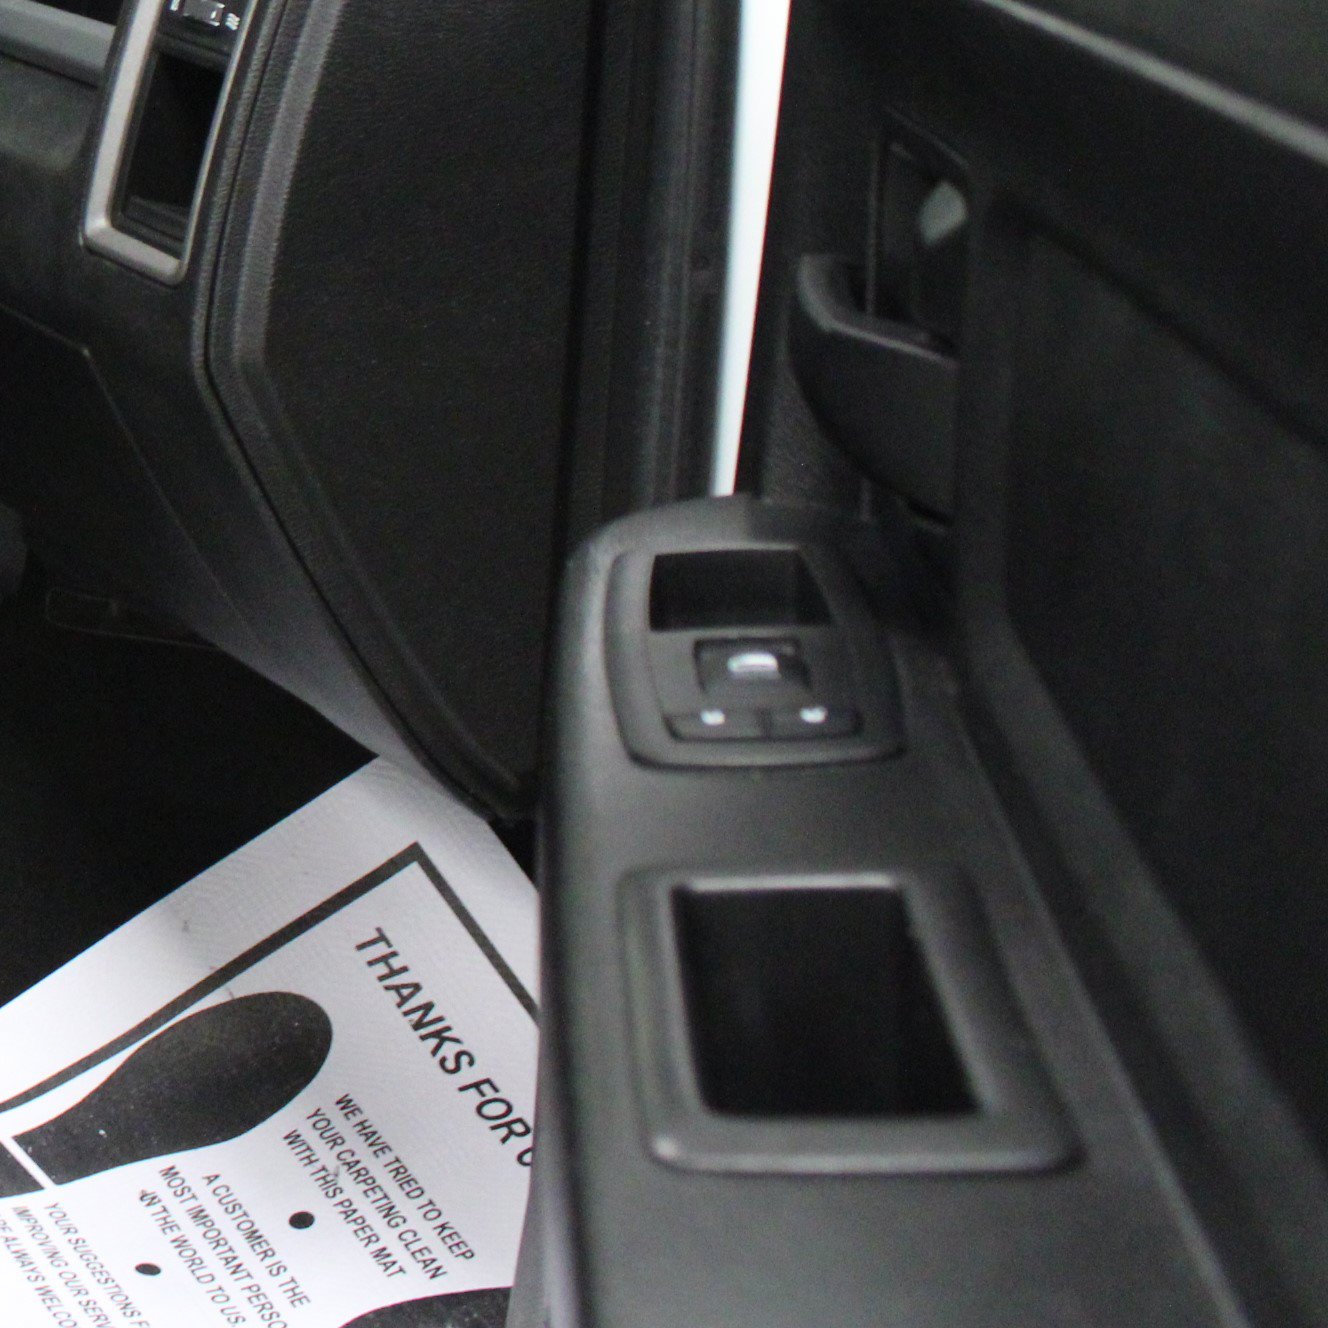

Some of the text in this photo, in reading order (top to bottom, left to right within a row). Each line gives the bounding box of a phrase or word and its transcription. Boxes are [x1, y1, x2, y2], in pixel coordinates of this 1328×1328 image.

[355, 927, 531, 1145] THANKS FOR
[159, 1165, 288, 1328] MOST IMPORTANT PERSO
[202, 1173, 311, 1309] A CUSTOMER IS THE
[282, 1129, 406, 1278] WITH THIS PAPER MAT
[306, 1107, 448, 1281] YOUR CARPETING CLEAN
[335, 1093, 475, 1262] WE HAVE TRIED TO KEEP
[0, 1235, 46, 1284] ALWAYS
[34, 1285, 77, 1328] WELCO
[12, 1205, 116, 1328] IMPROVING OUR SERV
[43, 1202, 142, 1319] YOUR SUGGESTIONS
[151, 1205, 181, 1236] THE
[170, 1234, 215, 1285] WORLD
[206, 1285, 230, 1305] TO
